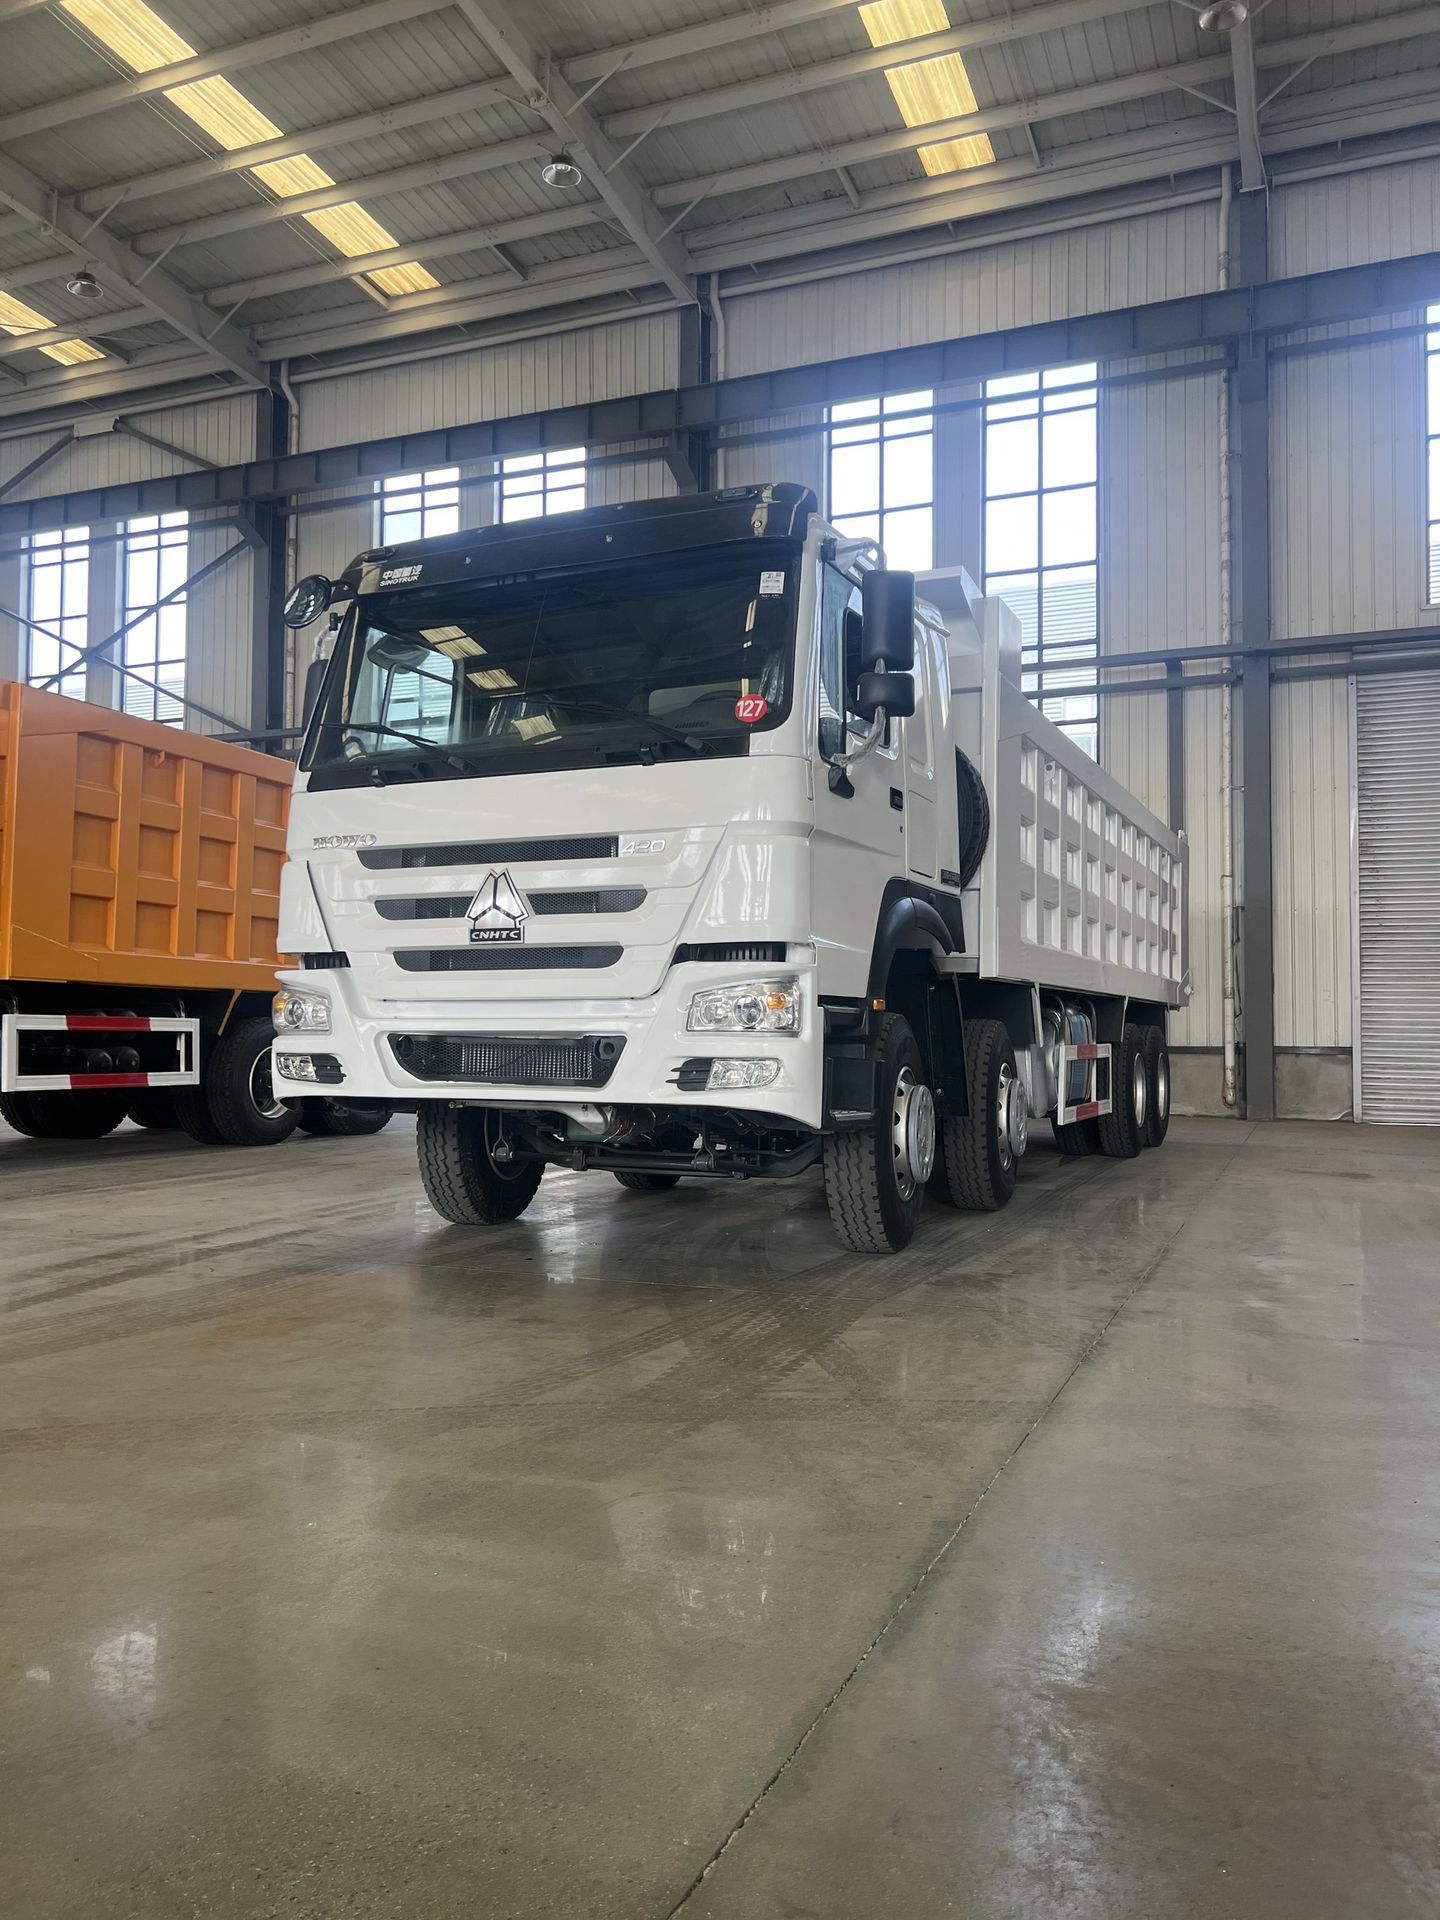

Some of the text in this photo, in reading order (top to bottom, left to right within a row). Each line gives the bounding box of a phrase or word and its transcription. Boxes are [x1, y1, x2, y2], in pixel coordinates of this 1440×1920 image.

[379, 575, 420, 587] SINOTRUK
[737, 700, 764, 717] 127
[312, 833, 377, 850] HOWO
[621, 839, 666, 855] 420
[471, 930, 520, 940] CNHTC
